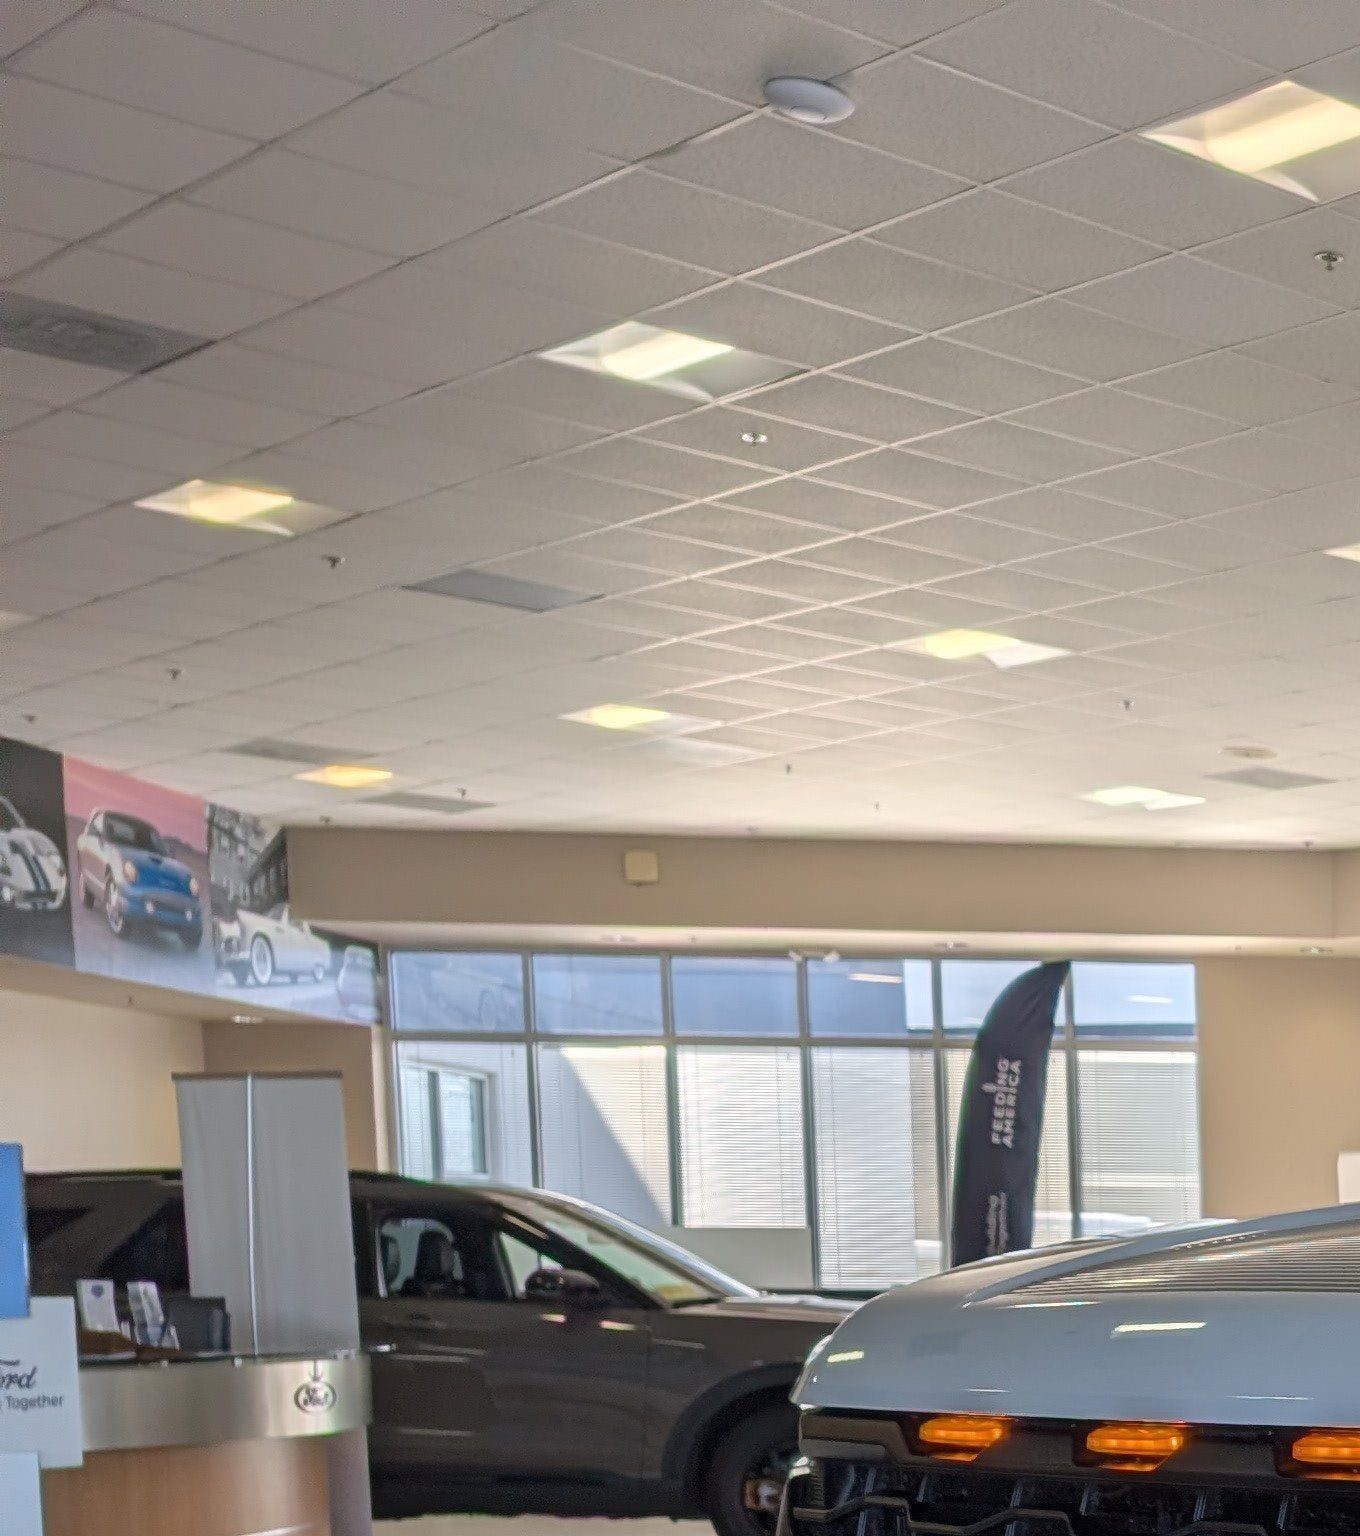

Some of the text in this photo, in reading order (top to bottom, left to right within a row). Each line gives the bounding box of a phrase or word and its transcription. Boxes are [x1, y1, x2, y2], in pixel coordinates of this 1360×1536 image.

[987, 1059, 1010, 1145] FEEDING
[1002, 1059, 1021, 1149] AMERICA
[6, 1395, 64, 1411] Together
